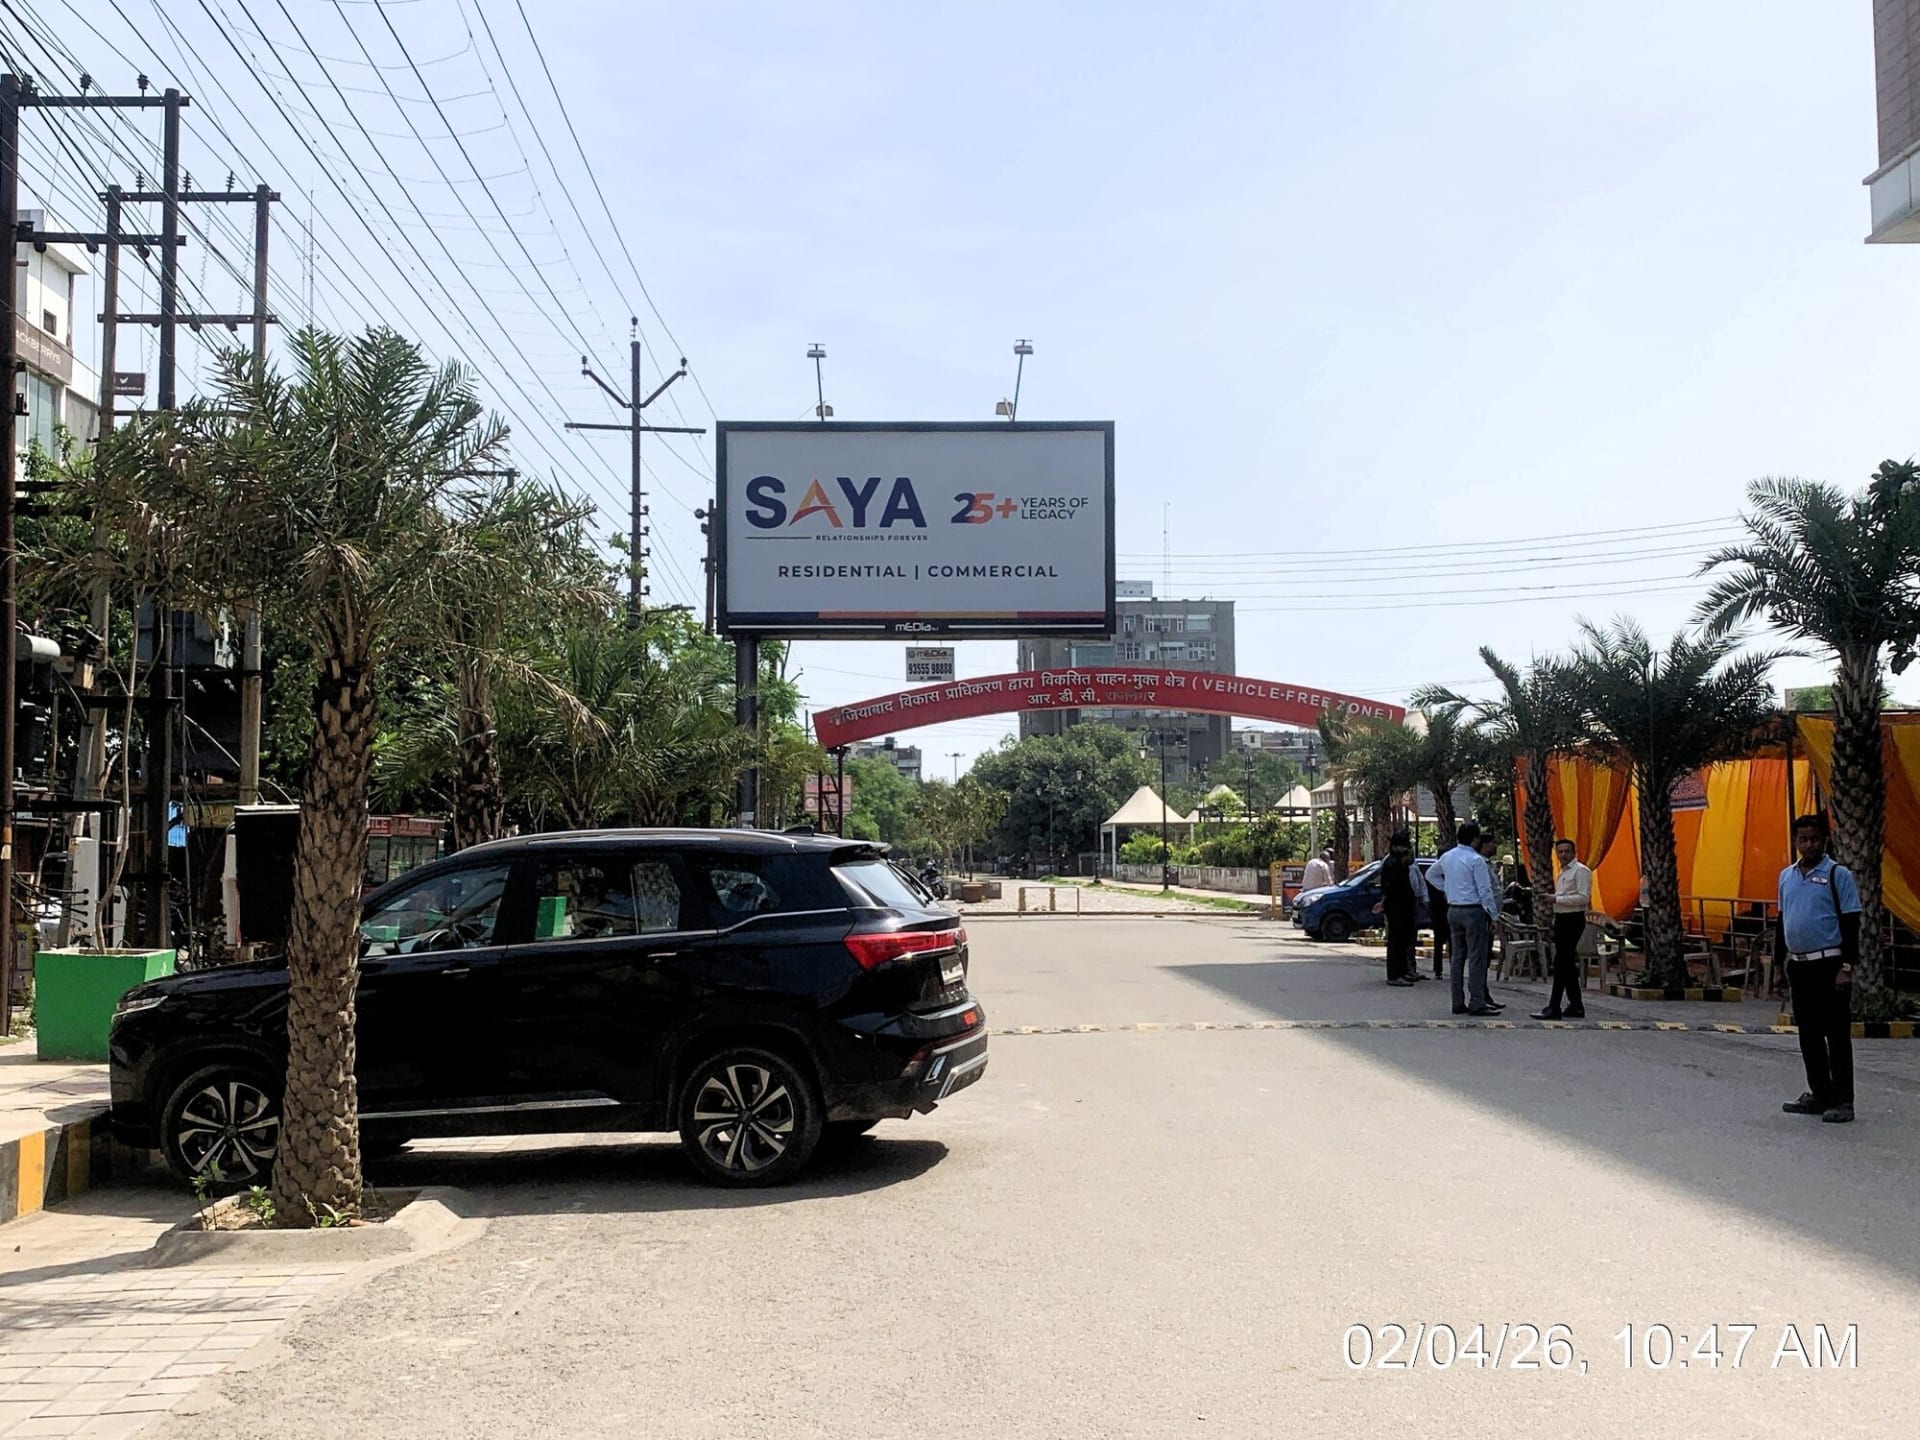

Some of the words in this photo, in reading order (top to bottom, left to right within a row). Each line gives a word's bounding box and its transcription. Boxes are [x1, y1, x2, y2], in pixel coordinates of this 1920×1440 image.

[745, 476, 928, 529] SAYA
[950, 492, 1018, 523] 25+
[1021, 497, 1066, 508] YEARS
[1069, 497, 1089, 508] OF
[1021, 509, 1076, 520] LEGACY
[778, 565, 907, 578] RESIDENTIAL
[928, 565, 1059, 578] COMMERCIAL
[900, 691, 940, 709] विकास
[946, 679, 1003, 700] प्राधिकरण
[1008, 676, 1034, 692] द्वारा
[1041, 669, 1091, 686] विकसित
[1164, 671, 1186, 688] क्षेत्र
